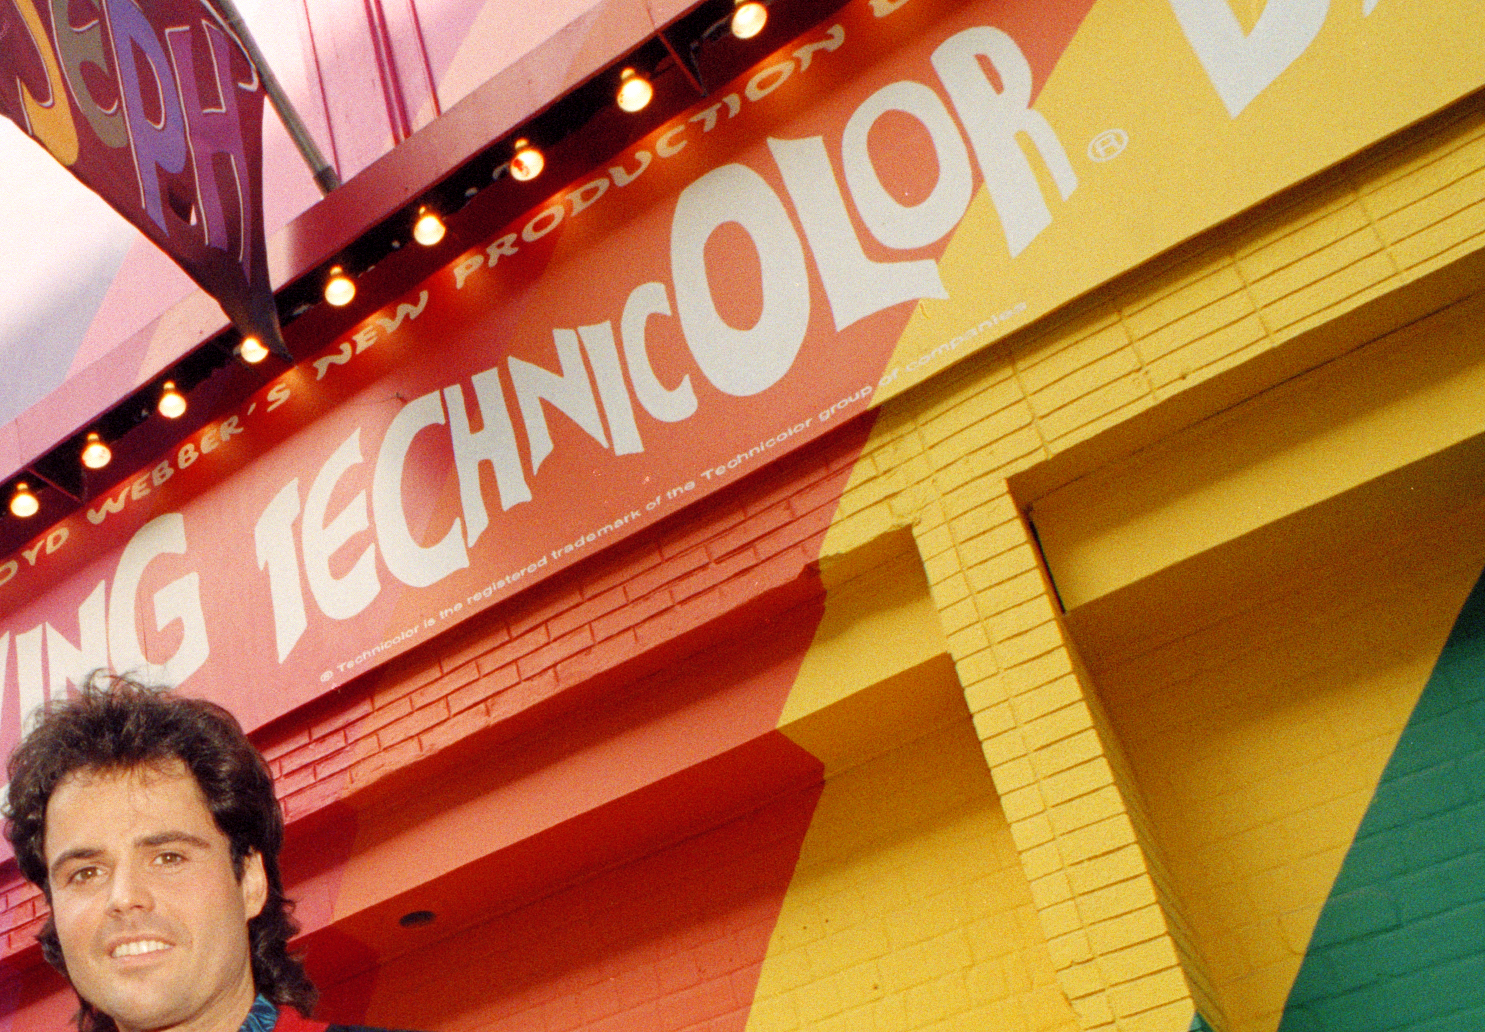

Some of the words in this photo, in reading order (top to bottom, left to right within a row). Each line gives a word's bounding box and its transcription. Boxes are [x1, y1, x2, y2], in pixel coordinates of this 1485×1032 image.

[86, 383, 291, 525] WEBBER'S
[313, 290, 429, 381] NEW
[453, 23, 846, 291] PRODUCTION
[253, 26, 1079, 664] TECHNICOLOR
[336, 625, 420, 673] Technicolor
[423, 615, 437, 630] is
[439, 601, 464, 620] the
[466, 554, 549, 607] registered
[551, 510, 643, 560] trademark
[645, 495, 663, 512] of
[666, 480, 697, 500] the
[701, 416, 814, 481] Technicolor
[818, 384, 874, 423] group
[878, 367, 900, 388] of
[906, 301, 1028, 373] companies
